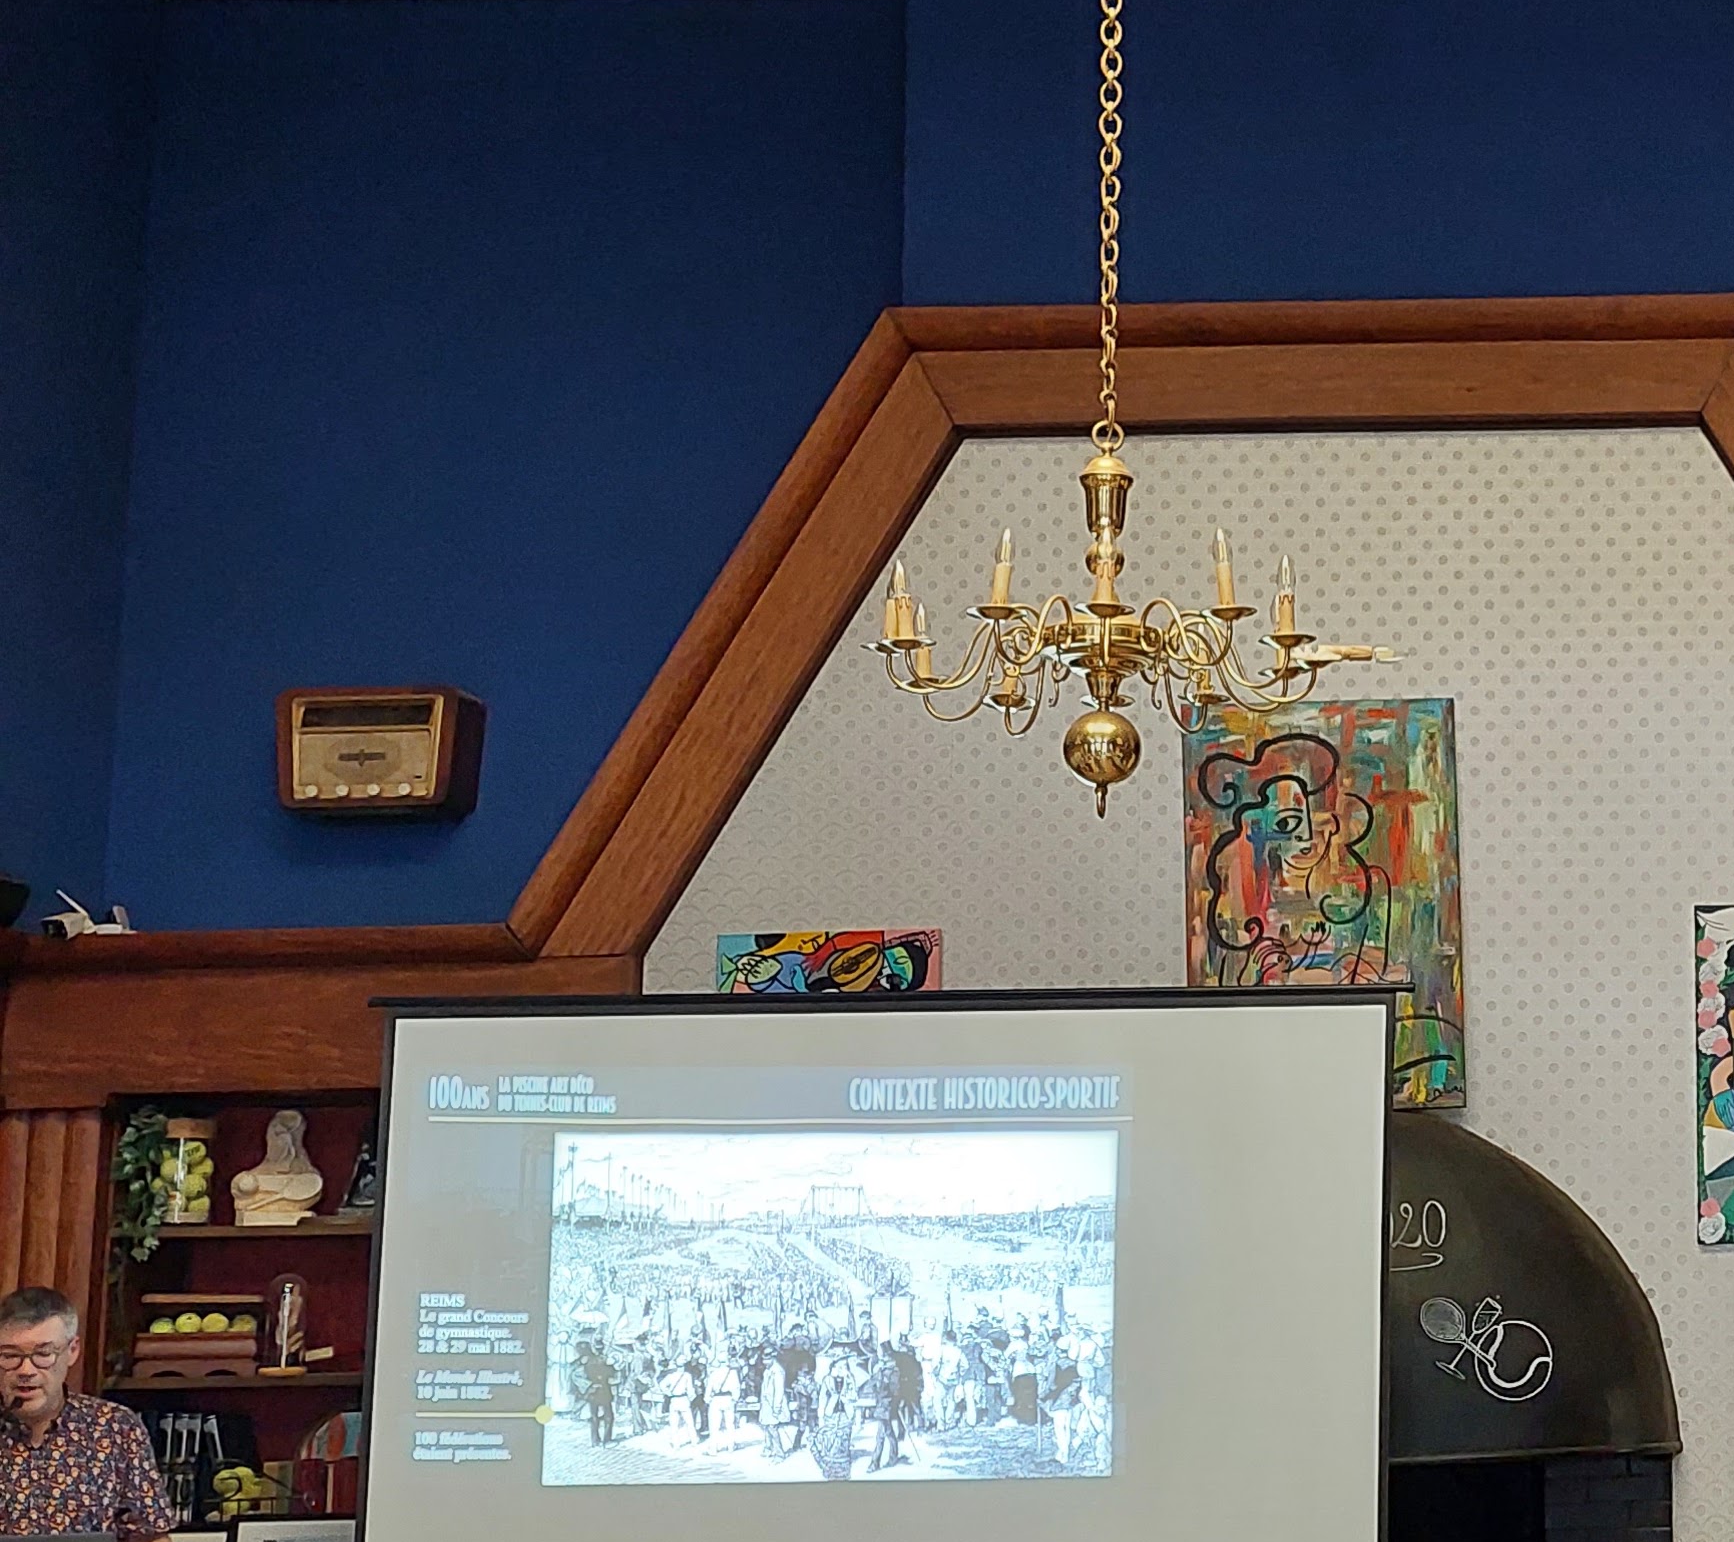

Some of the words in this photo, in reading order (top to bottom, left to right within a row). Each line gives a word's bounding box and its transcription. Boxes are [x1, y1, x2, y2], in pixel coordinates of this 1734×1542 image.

[849, 1077, 938, 1112] CONTEXTE
[943, 1075, 1121, 1110] HISTORICO-SPORTIF
[420, 1293, 466, 1308] REIMS
[437, 1309, 473, 1326] grand
[473, 1309, 530, 1324] Concours
[418, 1324, 435, 1338] de
